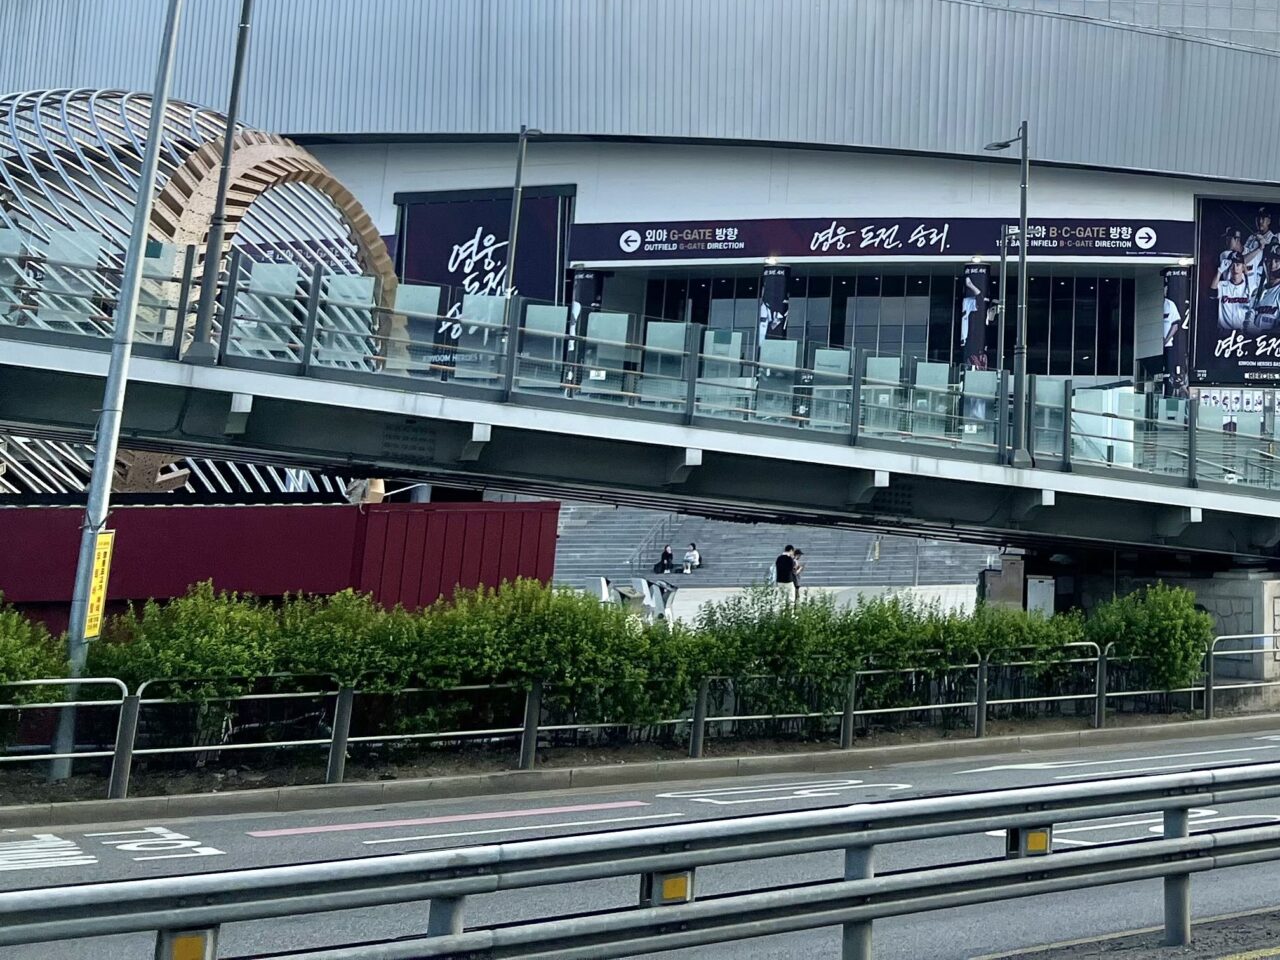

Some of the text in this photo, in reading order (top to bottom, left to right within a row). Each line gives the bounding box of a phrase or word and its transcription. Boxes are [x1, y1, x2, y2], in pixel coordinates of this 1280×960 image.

[644, 227, 738, 242] 외야 G-GATE 방향
[1003, 226, 1020, 239] 루
[1109, 226, 1132, 240] 방향
[644, 243, 678, 251] OUTFIELD
[707, 241, 745, 250] DIRECTION
[1031, 240, 1058, 248] INFIELD
[1095, 240, 1132, 248] DIRECTION
